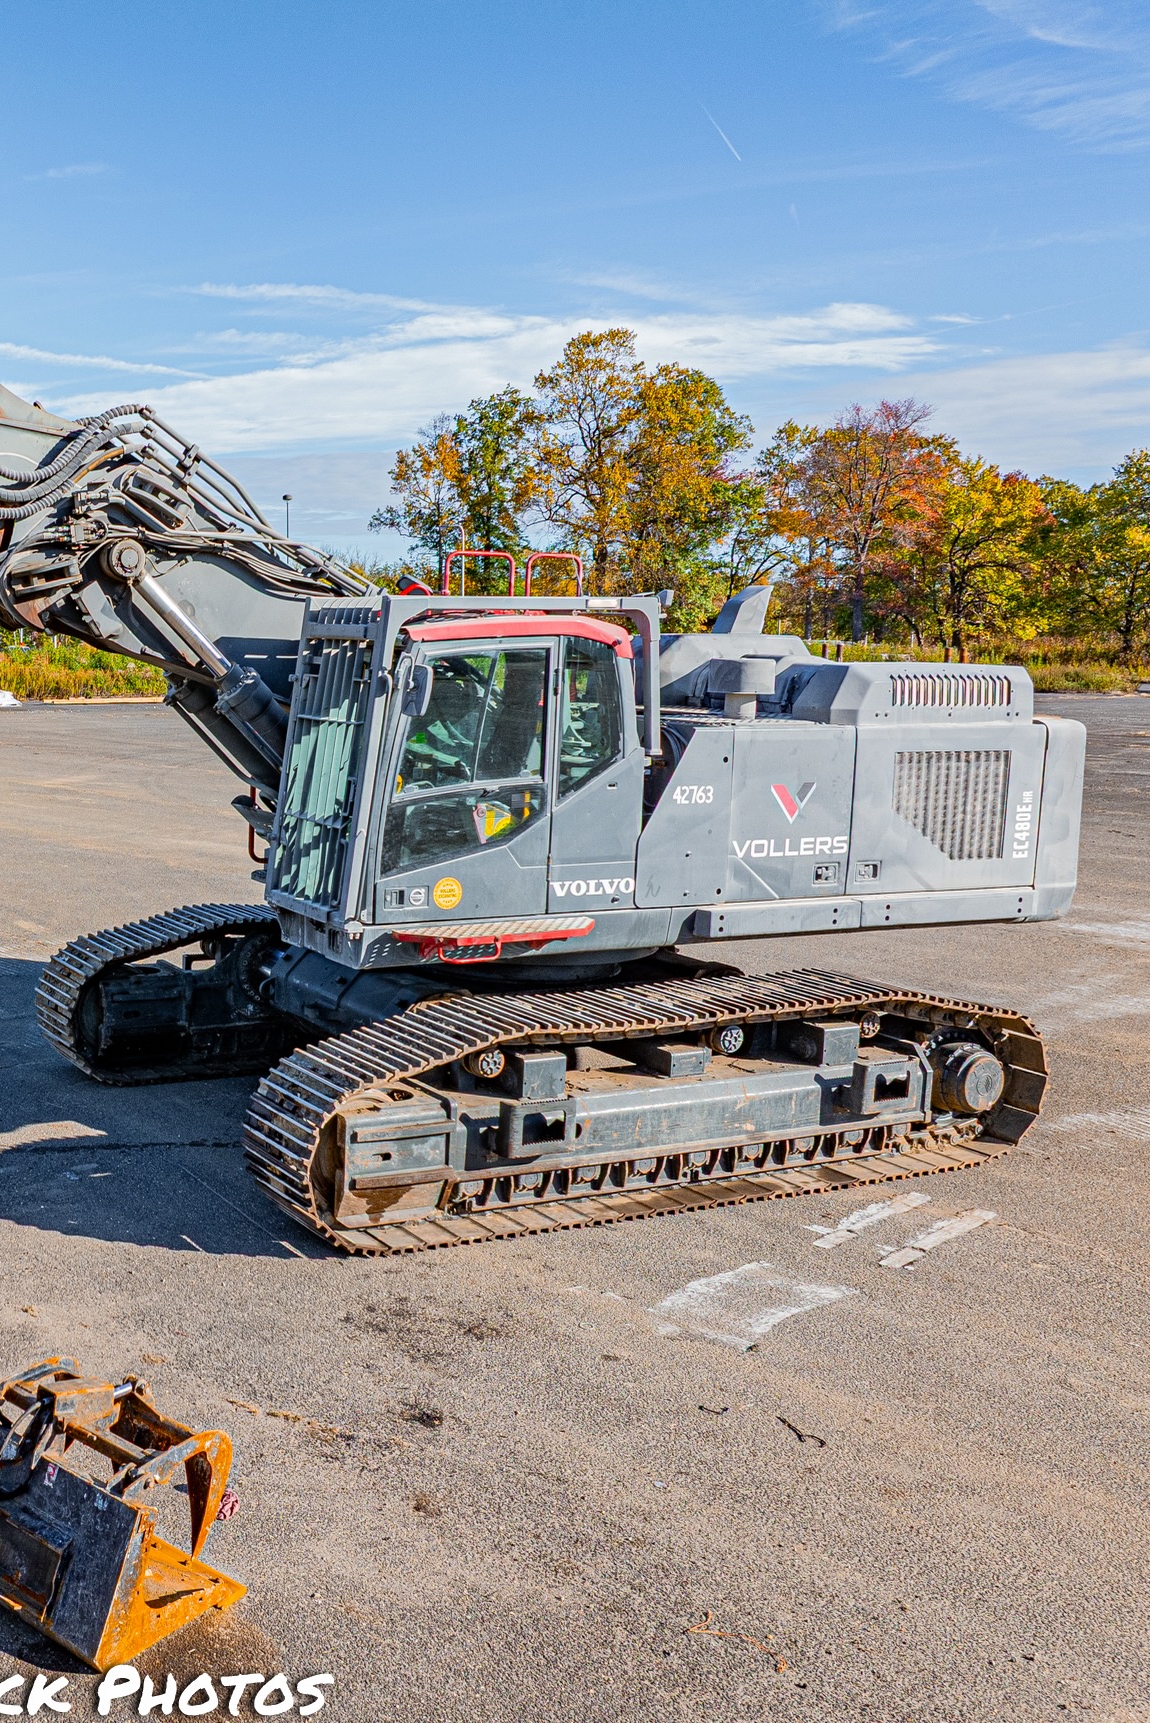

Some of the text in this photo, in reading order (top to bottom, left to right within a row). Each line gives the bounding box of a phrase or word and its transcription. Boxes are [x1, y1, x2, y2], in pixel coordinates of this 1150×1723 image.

[672, 785, 714, 805] 42763
[732, 835, 848, 859] VOLLERS
[550, 877, 636, 897] VOLVO
